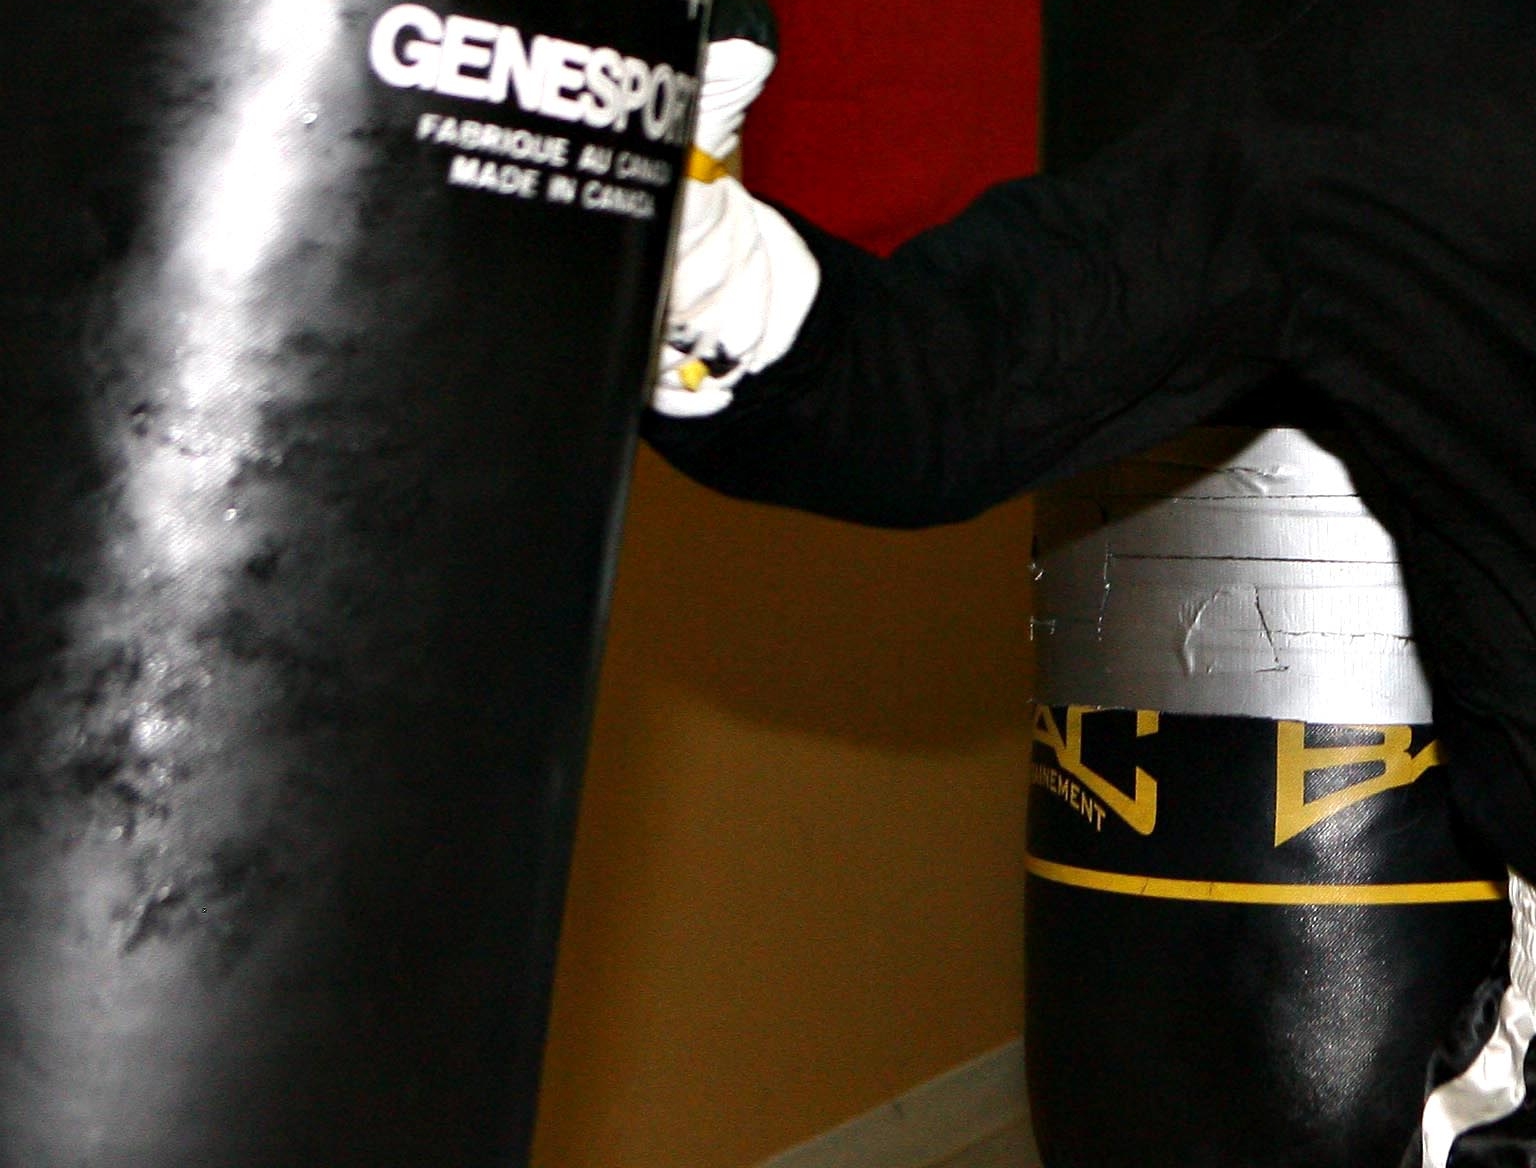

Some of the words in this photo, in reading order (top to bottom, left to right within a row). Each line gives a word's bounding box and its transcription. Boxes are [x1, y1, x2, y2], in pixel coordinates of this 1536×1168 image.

[416, 113, 569, 167] FABRIQUE
[578, 144, 612, 175] AU
[449, 155, 541, 199] MADE
[546, 173, 577, 205] IN
